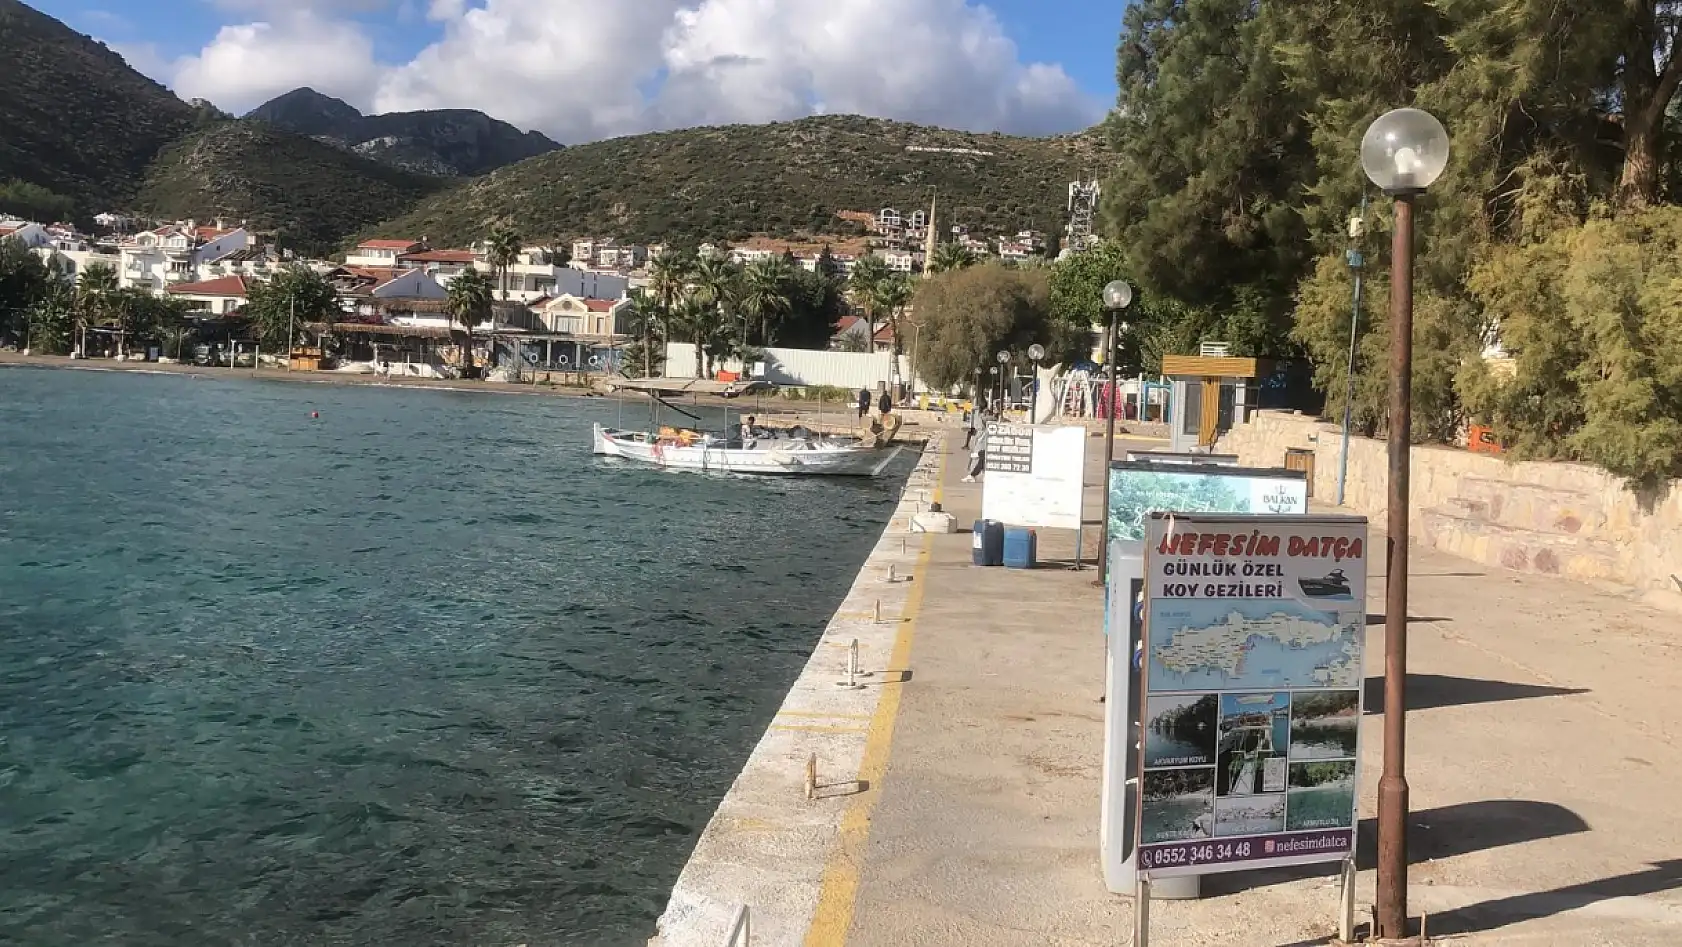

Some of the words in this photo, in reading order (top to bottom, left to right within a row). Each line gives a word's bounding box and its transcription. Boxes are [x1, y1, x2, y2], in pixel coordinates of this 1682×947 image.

[1263, 495, 1297, 505] BALKAN
[1158, 529, 1280, 556] NEFESİM
[1287, 535, 1363, 562] DATÇA
[1163, 559, 1237, 576] GÜNLÜK
[1242, 560, 1284, 577] ÖZEL
[1163, 583, 1199, 597] KOY
[1204, 581, 1283, 597] GEZİLERİ
[1155, 848, 1186, 864] 0552
[1190, 846, 1213, 862] 346
[1217, 843, 1233, 859] 34
[1235, 841, 1251, 858] 48
[1276, 835, 1347, 853] nefesimdatca
